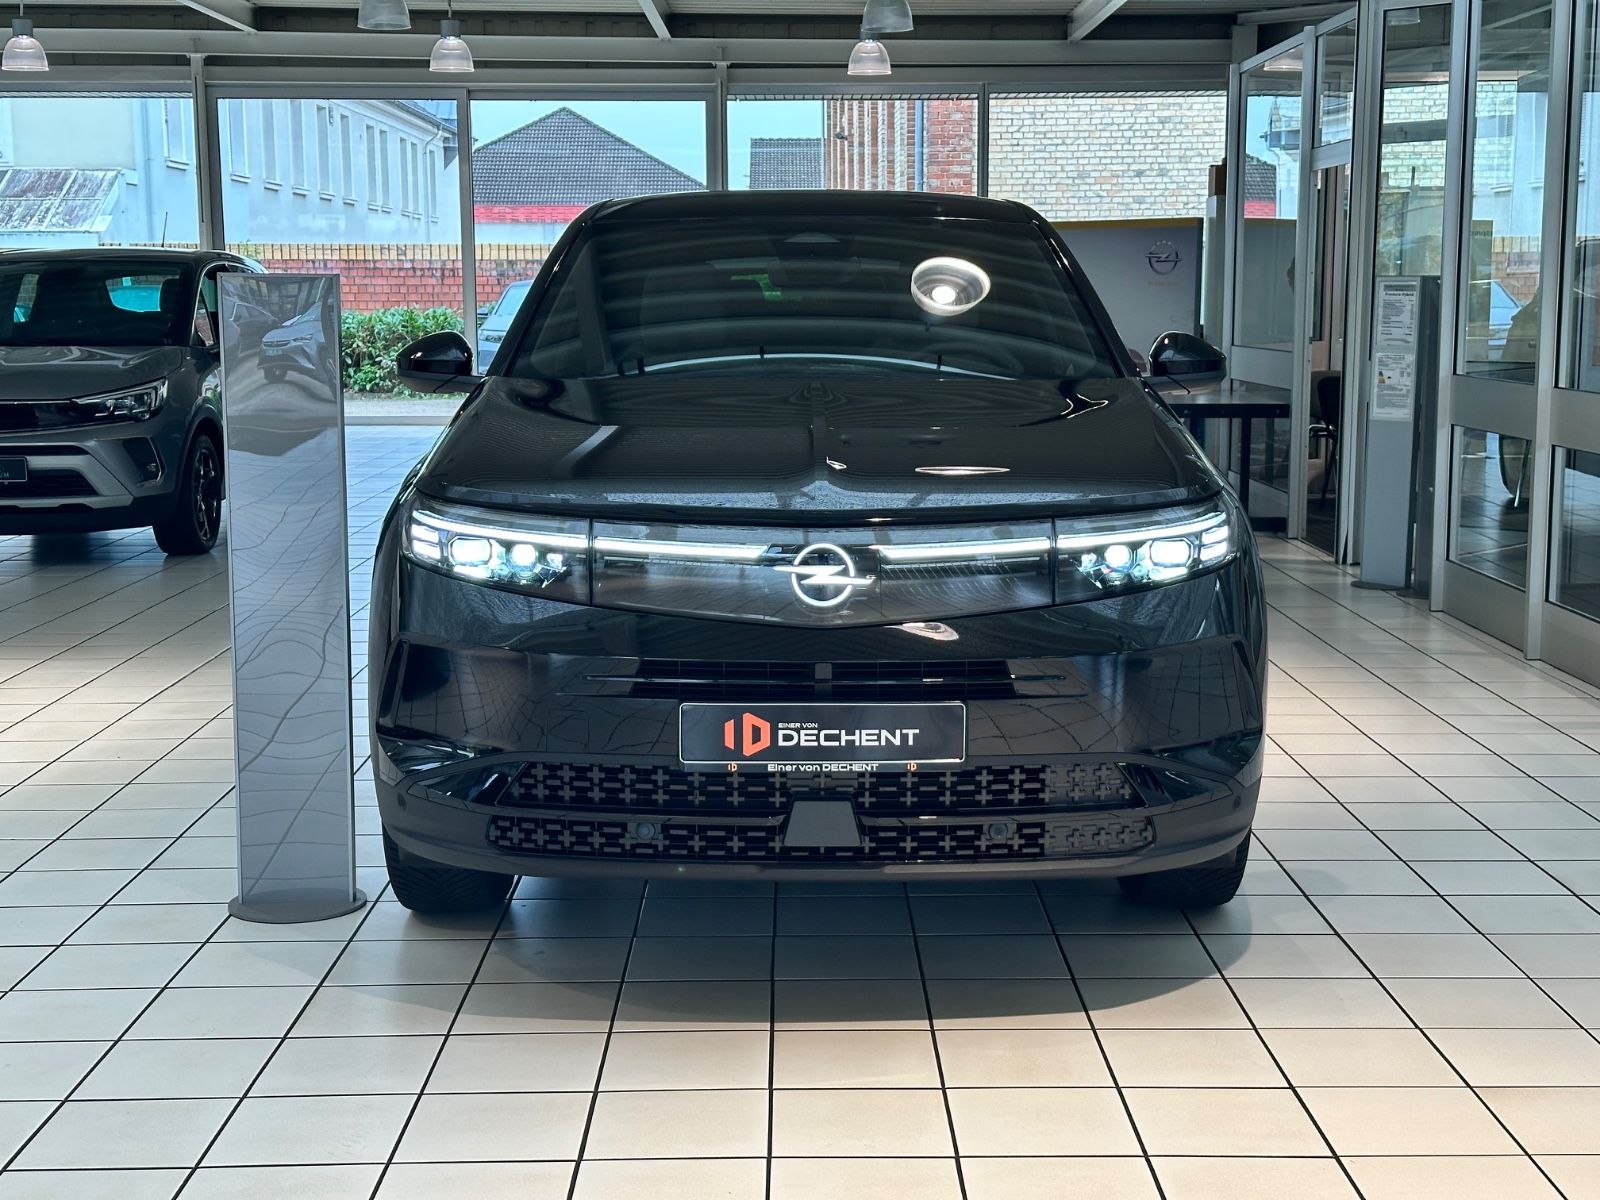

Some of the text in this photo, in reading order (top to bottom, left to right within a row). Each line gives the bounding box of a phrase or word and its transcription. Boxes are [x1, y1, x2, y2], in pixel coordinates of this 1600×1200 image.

[777, 728, 920, 747] DECHENT
[767, 763, 879, 772] Einer von DECHENT
